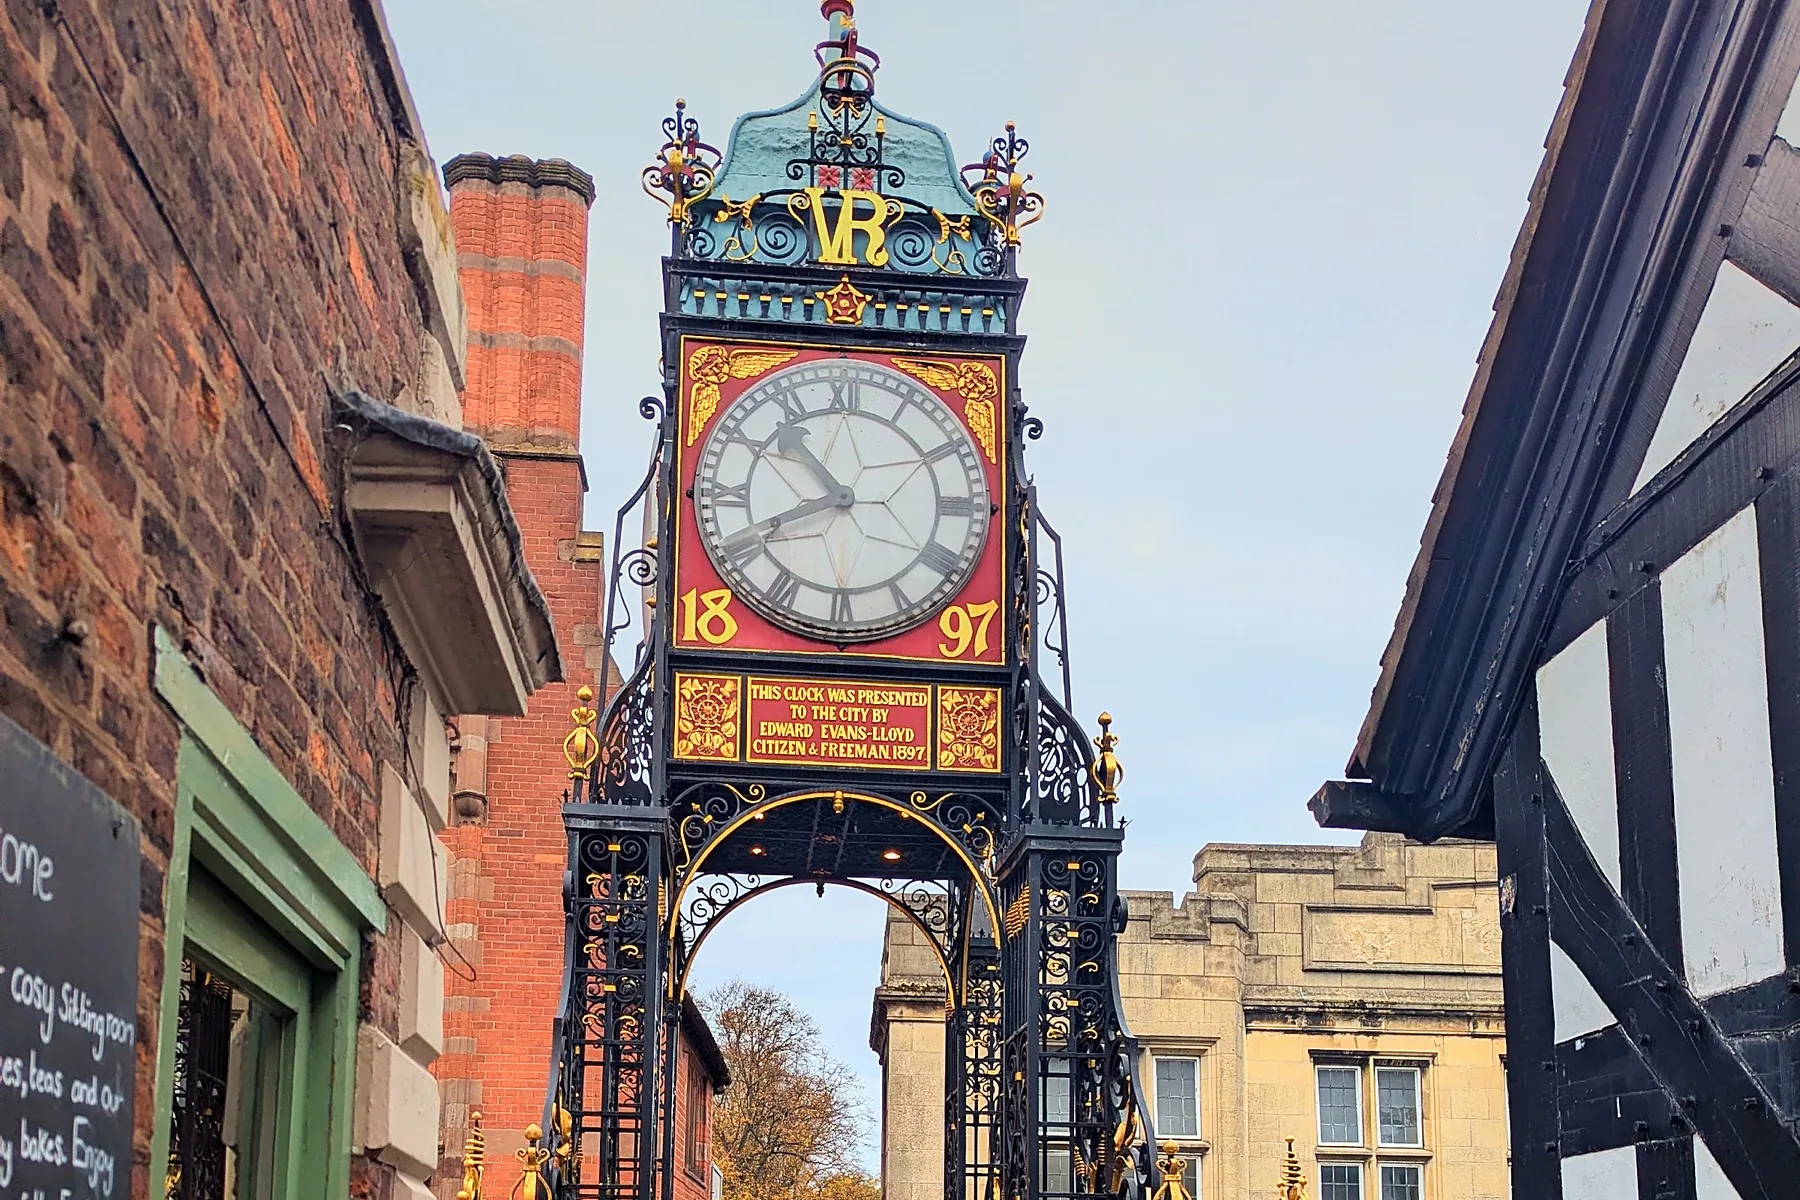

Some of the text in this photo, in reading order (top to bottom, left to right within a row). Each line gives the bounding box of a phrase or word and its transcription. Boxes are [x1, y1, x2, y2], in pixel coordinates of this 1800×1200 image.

[804, 187, 889, 267] VR
[828, 380, 860, 413] XII
[680, 587, 739, 645] 18
[937, 599, 999, 658] 97
[751, 684, 928, 707] THIS CLOCK WAS PRESENTED
[790, 704, 889, 723] TO THE CITY BY
[753, 739, 806, 756] CITIZEN
[808, 743, 819, 756] &
[759, 722, 915, 742] EDWARD EVANS-LLOYD
[0, 832, 55, 902] ome
[0, 1055, 28, 1099] es,
[71, 1075, 98, 1106] and
[72, 1115, 114, 1197] Enjoy
